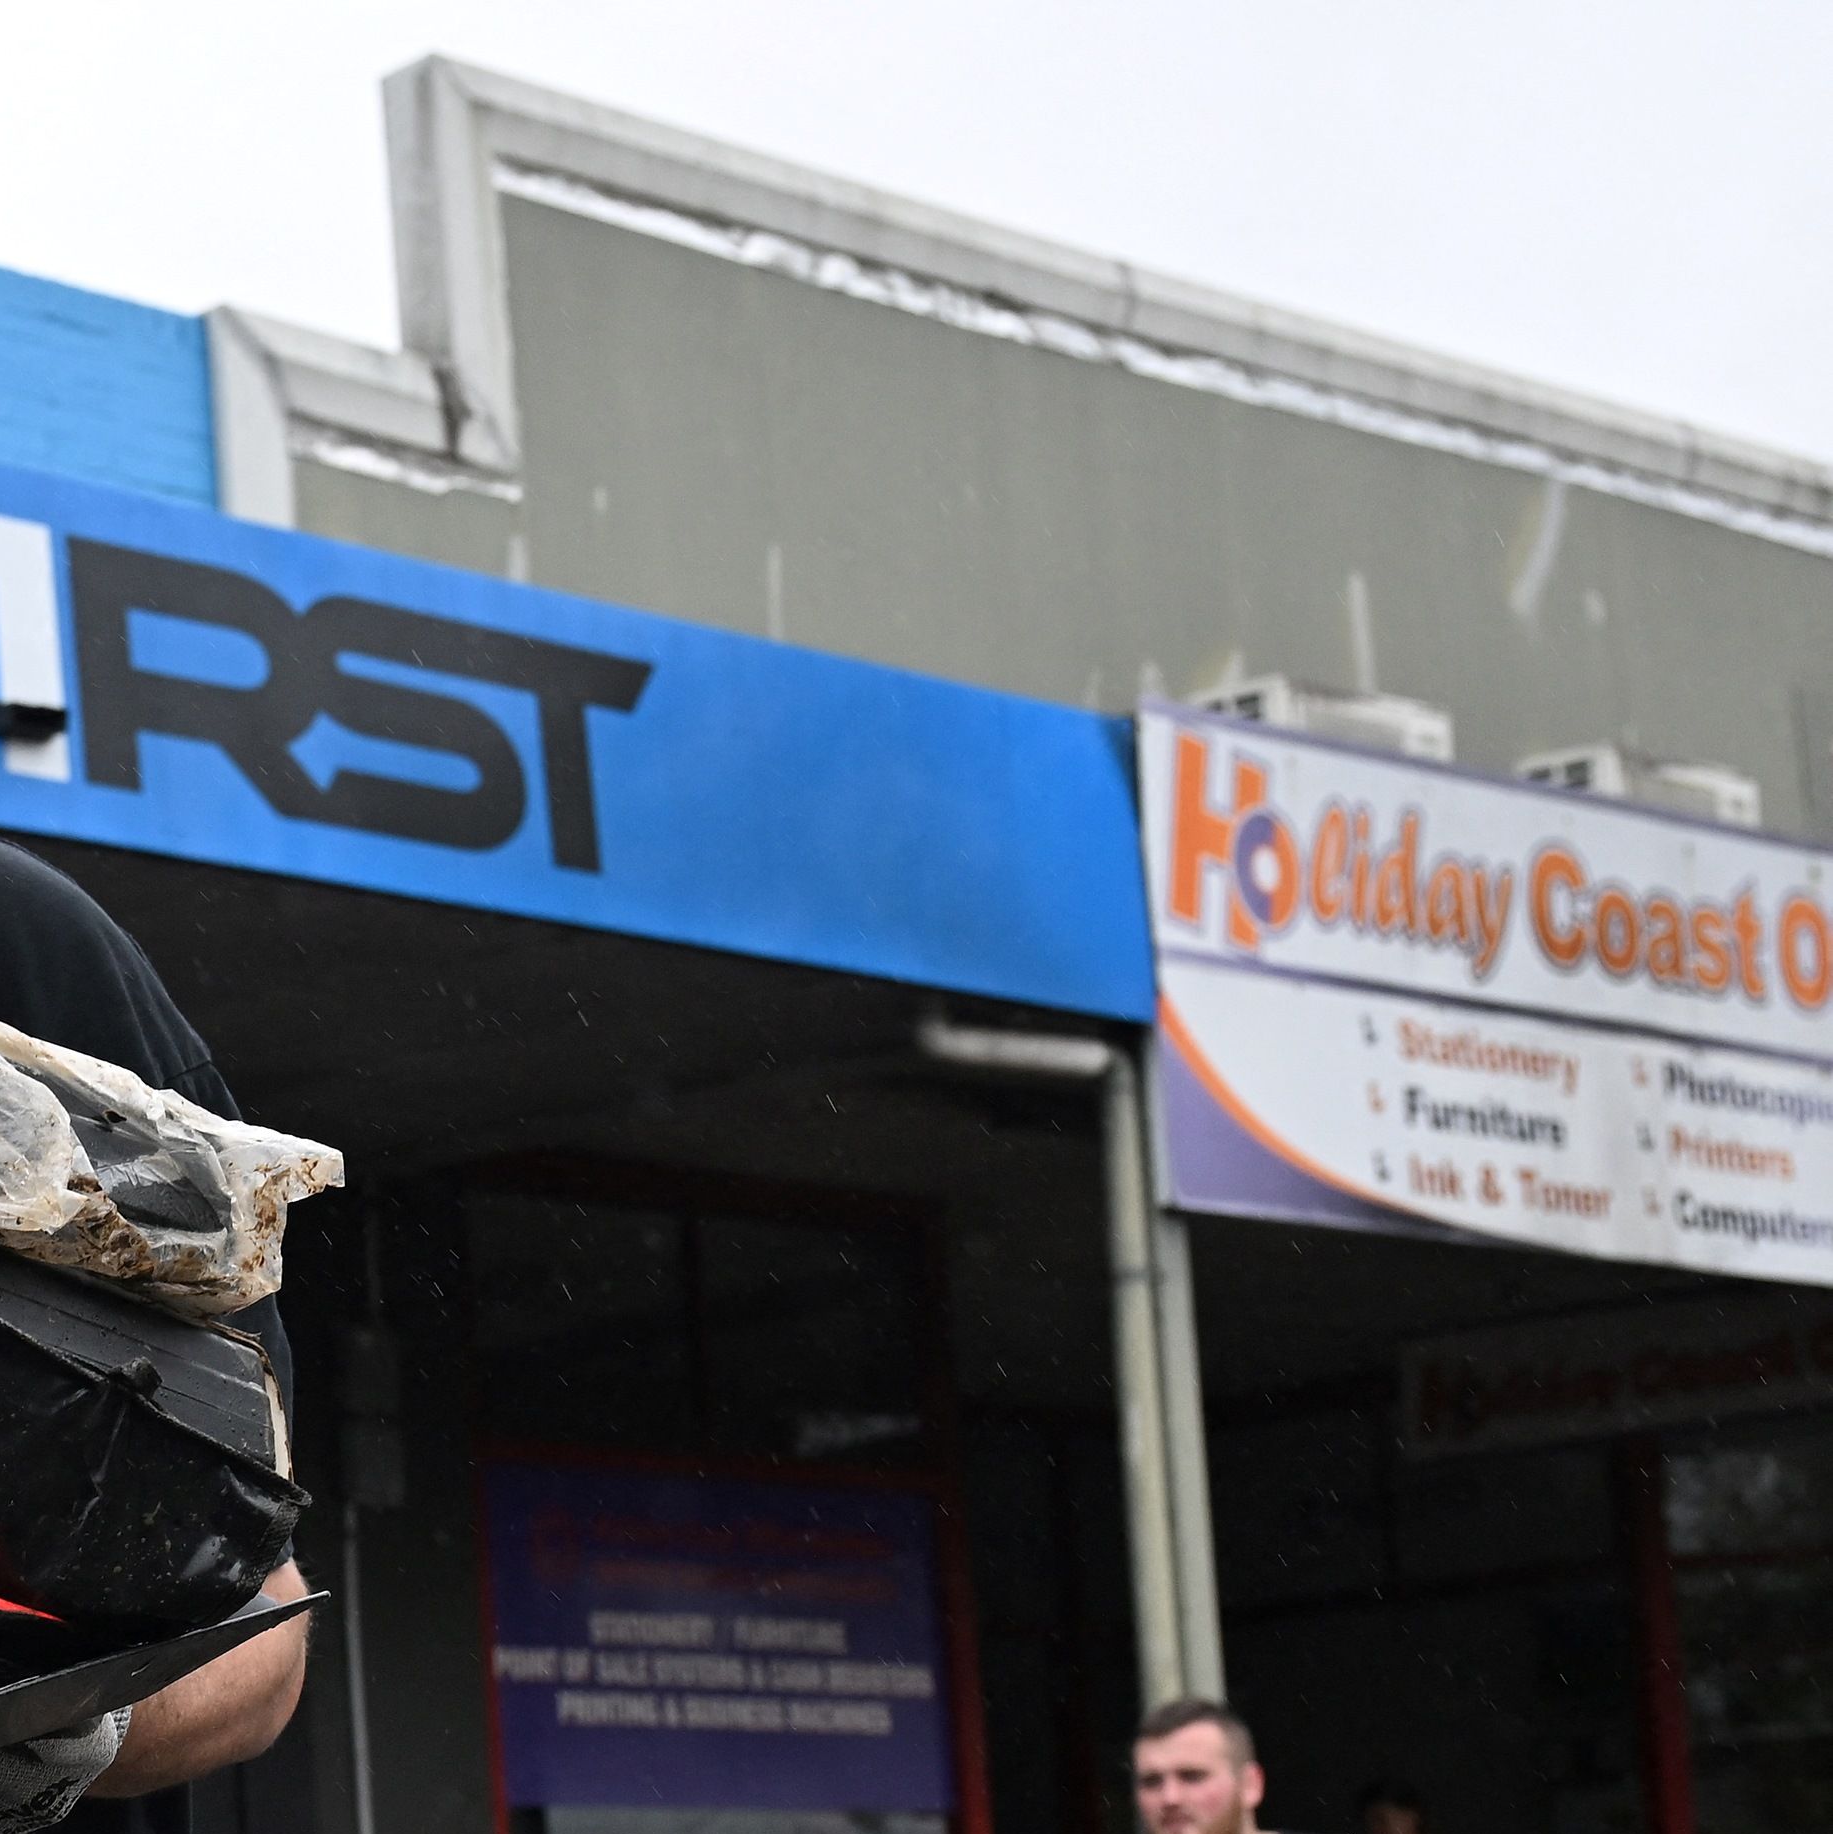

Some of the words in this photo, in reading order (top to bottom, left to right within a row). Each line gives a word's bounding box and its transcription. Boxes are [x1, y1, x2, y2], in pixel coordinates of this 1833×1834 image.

[1169, 730, 1514, 981] Holiday
[1530, 845, 1766, 1000] Coast
[1398, 1018, 1579, 1096] Stationery
[1403, 1085, 1568, 1150] Furniture
[1408, 1152, 1464, 1199] Ink
[1479, 1161, 1504, 1207] &
[1516, 1165, 1614, 1219] Toner
[1669, 1124, 1796, 1182] Printers
